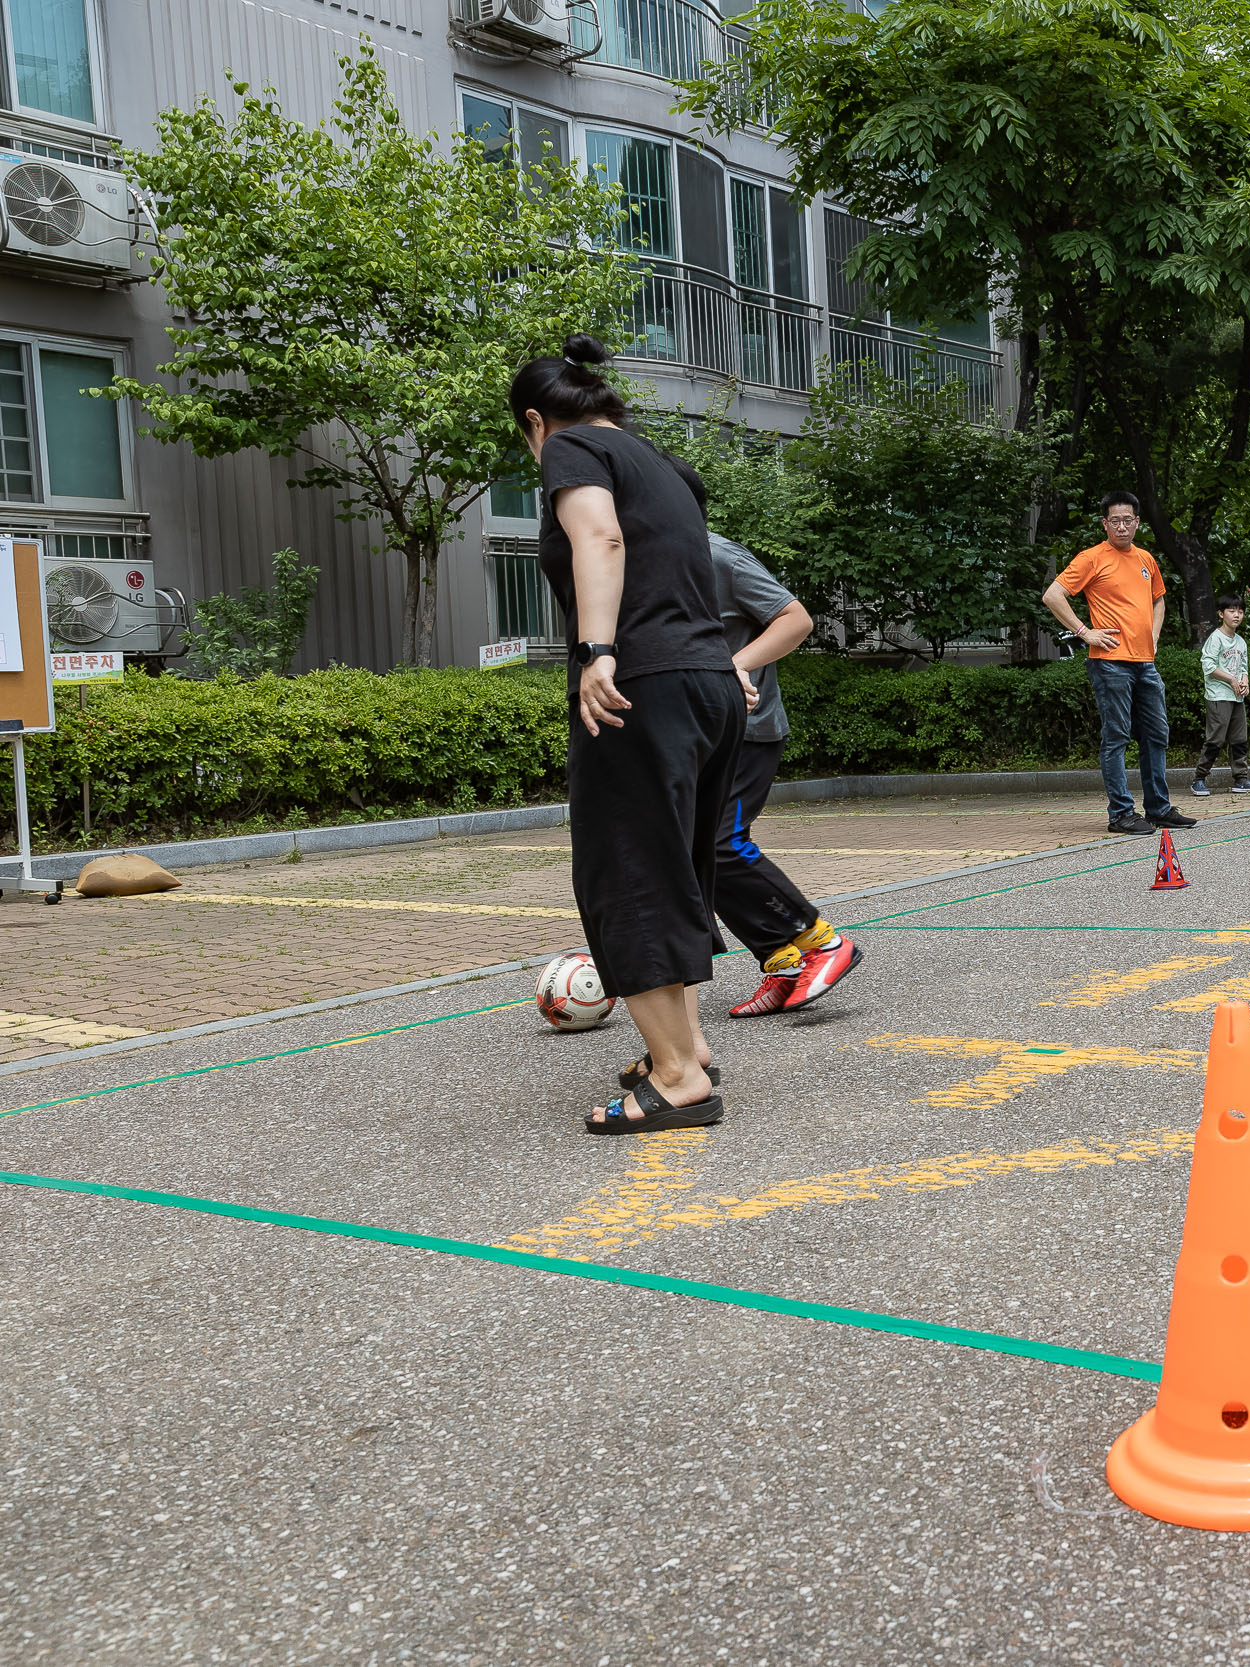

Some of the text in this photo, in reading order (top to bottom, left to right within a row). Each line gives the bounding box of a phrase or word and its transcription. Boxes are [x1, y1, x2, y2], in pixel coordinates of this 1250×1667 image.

[129, 593, 143, 602] LG
[485, 641, 522, 659] 전면주차
[53, 655, 114, 670] 전면주차
